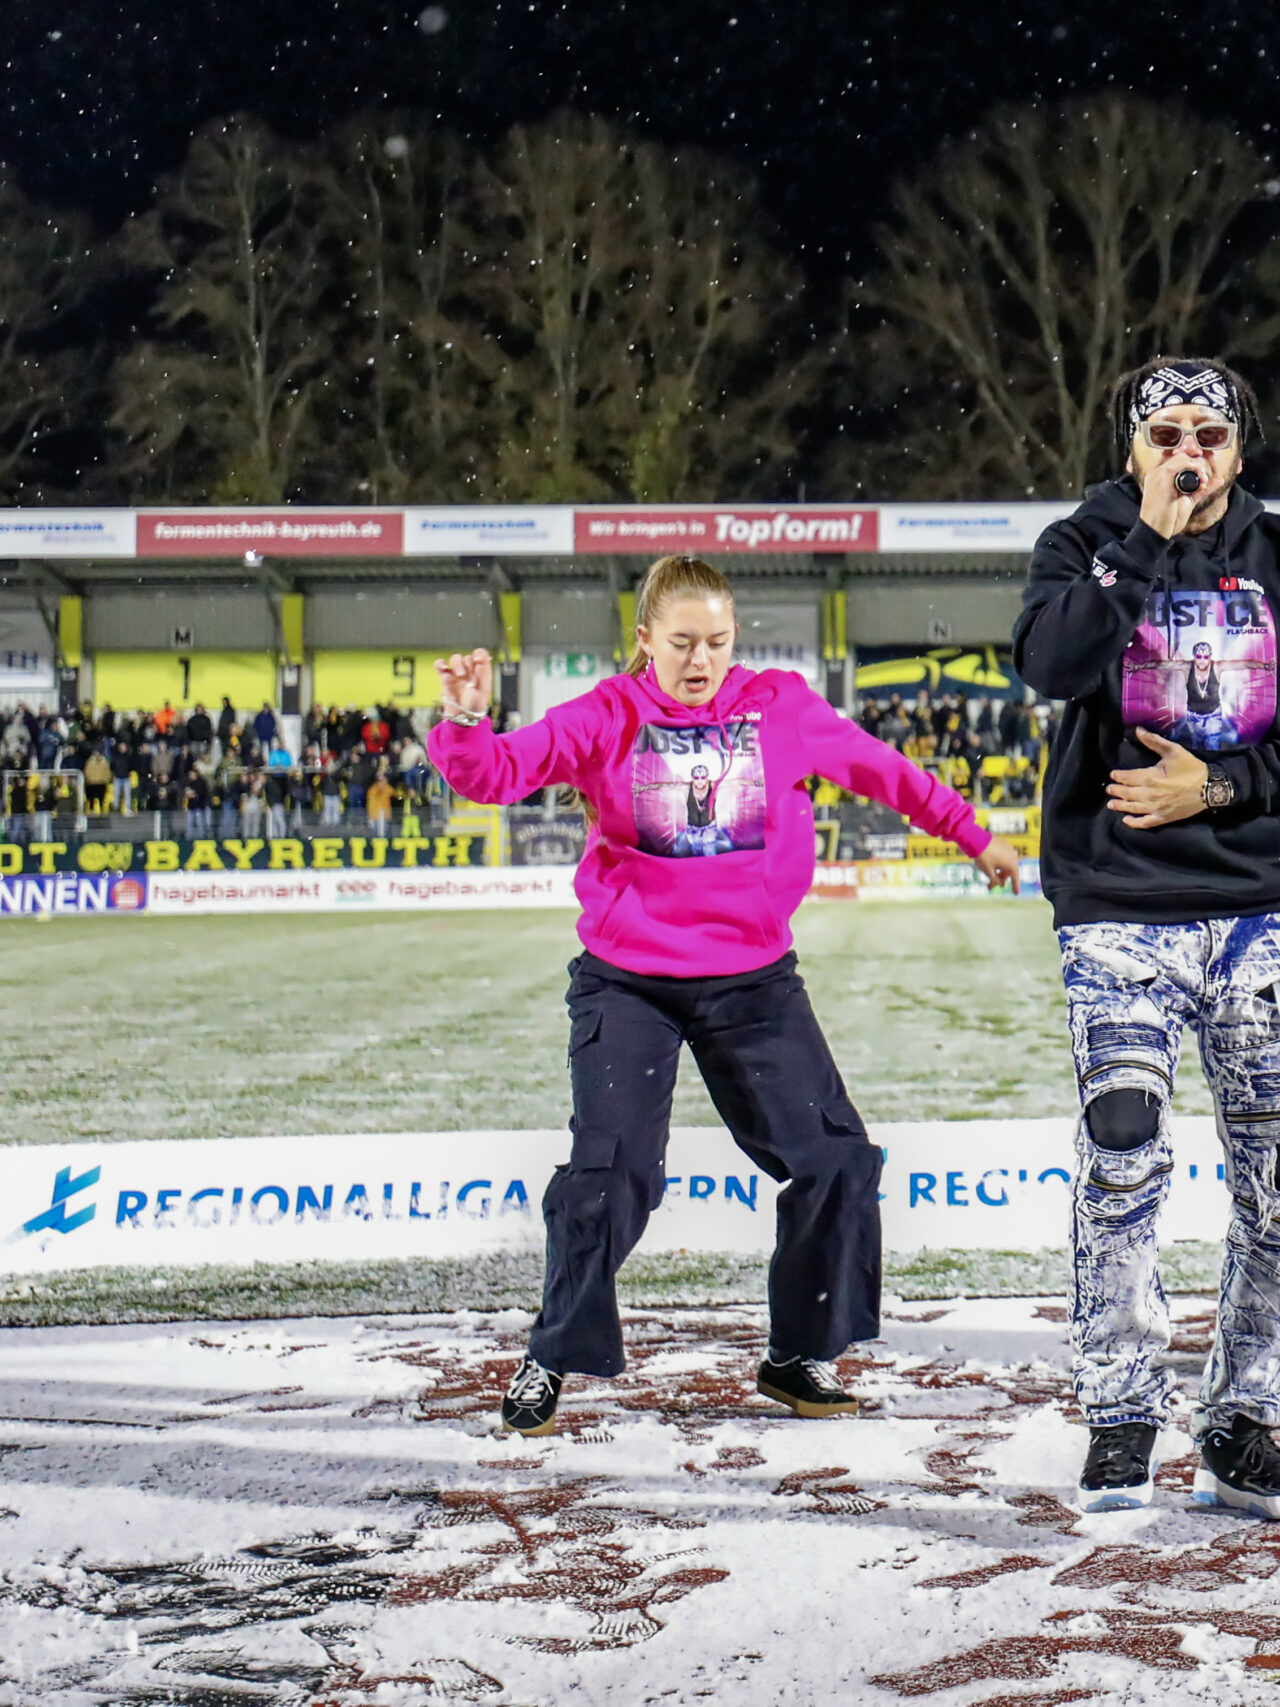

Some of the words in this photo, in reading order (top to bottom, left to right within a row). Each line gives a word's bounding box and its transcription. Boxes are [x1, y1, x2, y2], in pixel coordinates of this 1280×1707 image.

[154, 521, 383, 542] formentechnik-bayreuth.de
[714, 513, 863, 546] Topform!
[175, 628, 191, 645] M
[393, 655, 415, 697] 9
[145, 837, 471, 873] BAYREUTH
[153, 880, 320, 903] hagebaumarkt
[389, 877, 553, 900] hagebaumarkt
[115, 1179, 532, 1228] REGIONALLIGA
